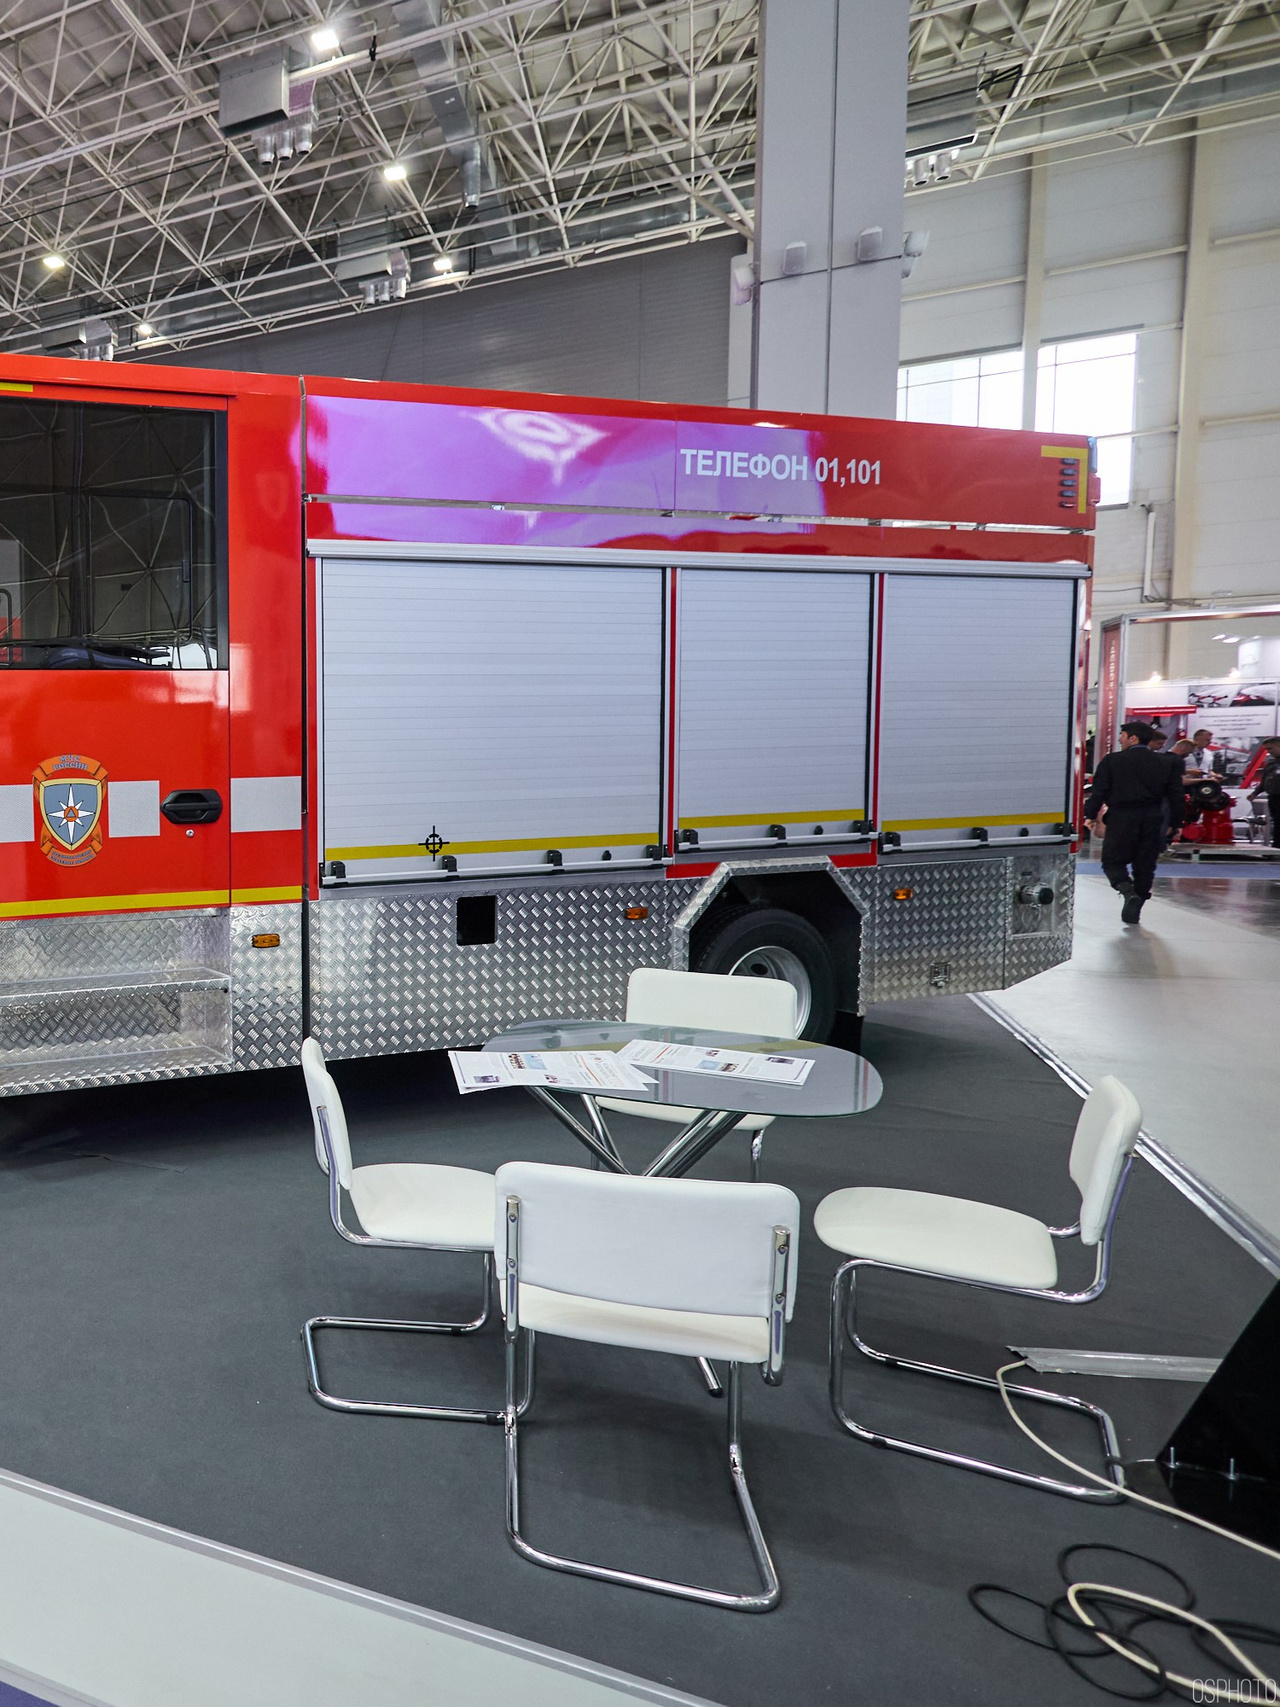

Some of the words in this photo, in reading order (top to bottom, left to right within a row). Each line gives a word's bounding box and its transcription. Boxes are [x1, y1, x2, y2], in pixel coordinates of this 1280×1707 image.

[680, 448, 808, 481] ТЕЛЕФОН
[815, 457, 881, 487] 01,101
[60, 754, 80, 762] МЧС
